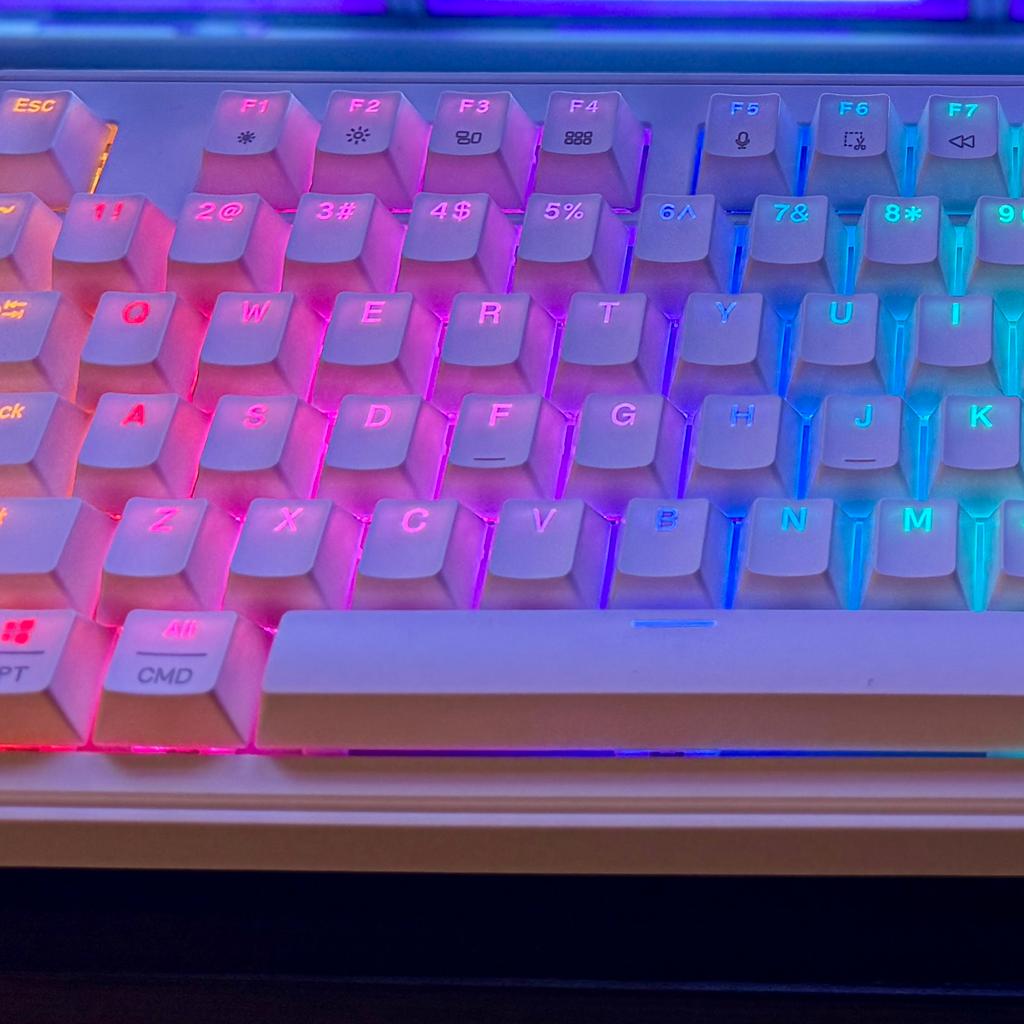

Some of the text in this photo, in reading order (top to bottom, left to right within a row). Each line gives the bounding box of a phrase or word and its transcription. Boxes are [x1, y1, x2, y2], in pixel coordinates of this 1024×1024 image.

[241, 99, 269, 113] F1
[349, 98, 381, 113] F2
[459, 99, 490, 113] F3
[569, 99, 599, 113] F4
[731, 101, 760, 116] F5
[839, 101, 869, 116] F6
[949, 103, 979, 118] F7
[242, 301, 271, 324] W
[361, 301, 386, 324] E
[479, 301, 501, 324] R
[599, 301, 619, 324] T
[715, 301, 737, 324] Y
[829, 301, 853, 326] U
[120, 404, 146, 427] A
[243, 404, 269, 429] S
[365, 404, 392, 429] D
[488, 403, 512, 427] F
[611, 402, 637, 426] G
[729, 404, 755, 427] H
[855, 404, 874, 428] J
[969, 404, 993, 428] K
[149, 507, 180, 532] Z
[273, 507, 303, 532] X
[401, 508, 429, 533] C
[532, 508, 557, 533] V
[655, 507, 679, 532] B
[780, 507, 808, 532] N
[903, 507, 934, 532] M
[137, 667, 193, 684] CMD
